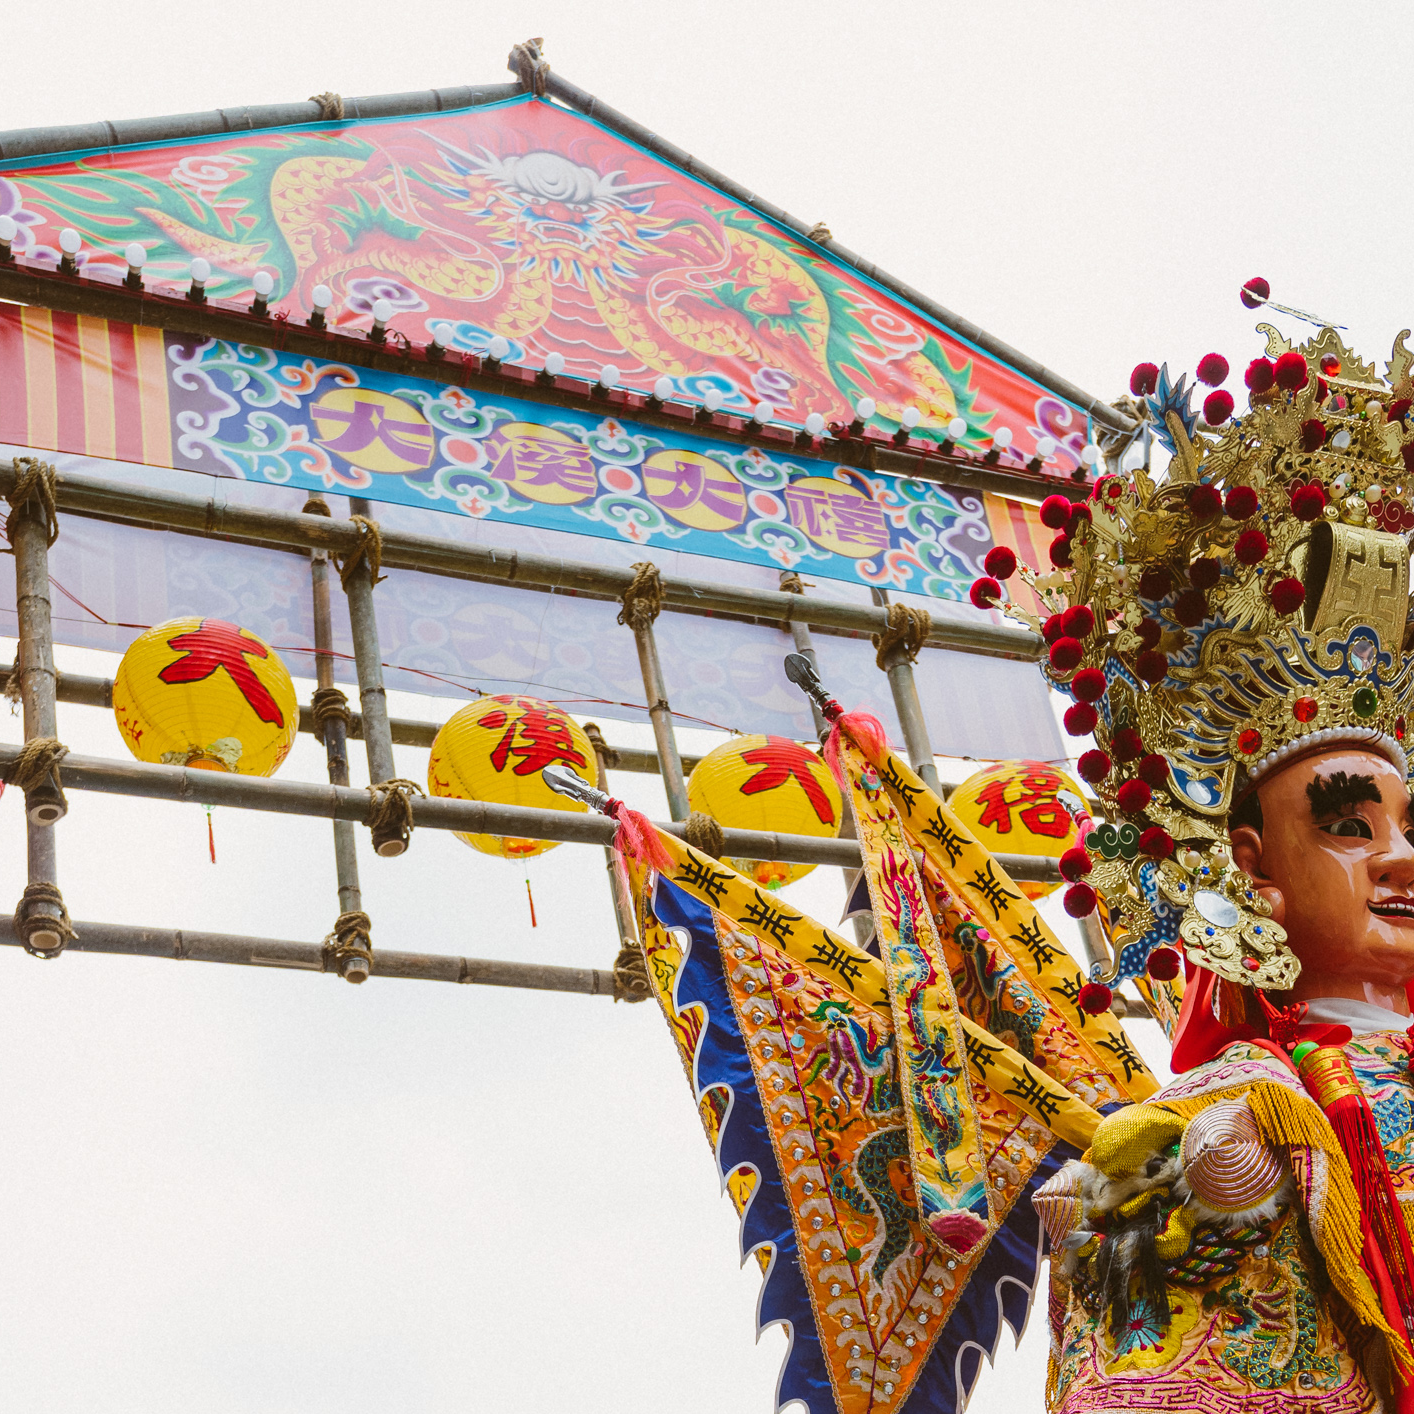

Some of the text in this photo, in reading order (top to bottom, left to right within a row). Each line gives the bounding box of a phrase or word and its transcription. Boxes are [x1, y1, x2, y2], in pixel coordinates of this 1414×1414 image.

[310, 400, 893, 555] 大溪大禧
[158, 617, 285, 729] 大
[739, 735, 836, 827] 大
